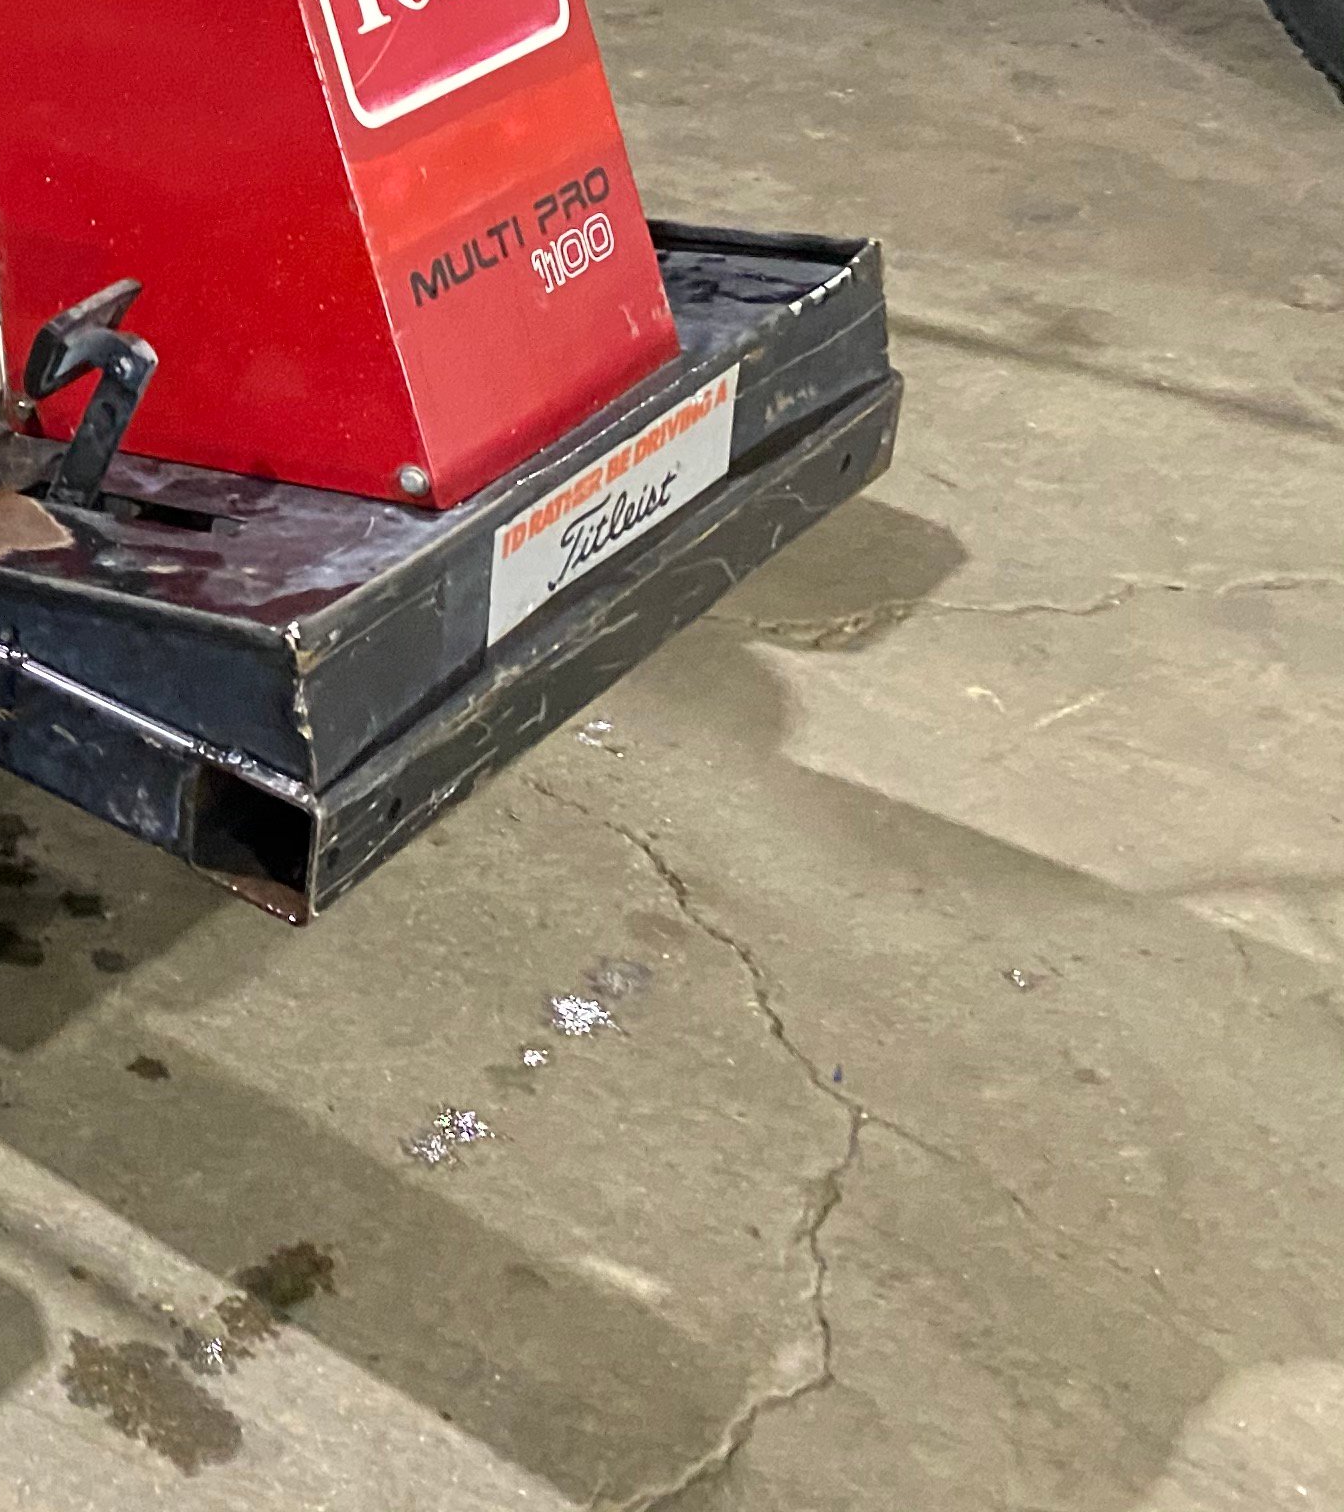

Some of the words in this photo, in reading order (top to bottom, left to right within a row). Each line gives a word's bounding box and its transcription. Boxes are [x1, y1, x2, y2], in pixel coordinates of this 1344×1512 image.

[409, 216, 525, 307] MULTI
[533, 166, 610, 235] PRO
[531, 212, 614, 294] 1100
[528, 467, 603, 540] RATHER
[606, 446, 633, 484] BE
[634, 389, 712, 467] DRIVING
[714, 378, 727, 407] A
[548, 471, 677, 592] Titleist
